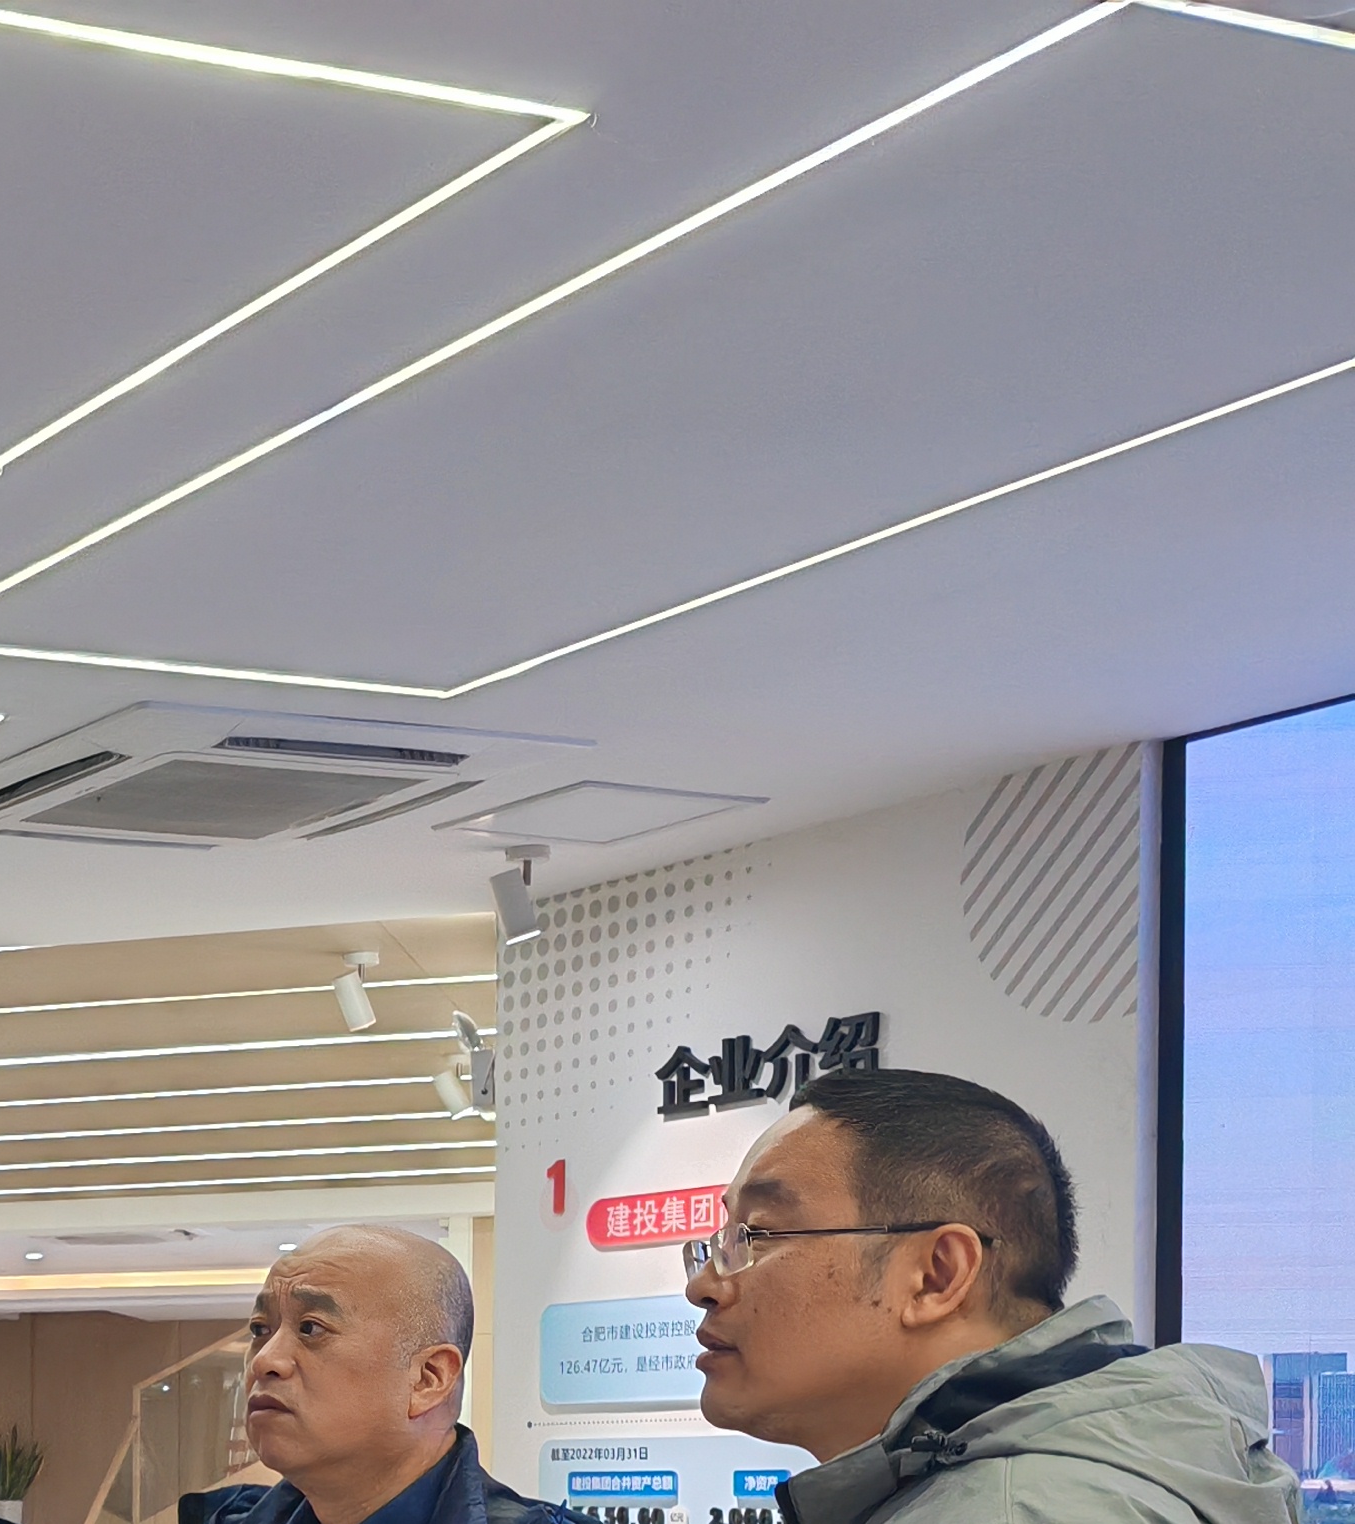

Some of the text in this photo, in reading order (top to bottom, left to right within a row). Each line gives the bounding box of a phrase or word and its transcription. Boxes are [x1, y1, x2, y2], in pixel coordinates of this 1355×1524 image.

[654, 1012, 880, 1115] 企业介绍
[546, 1159, 566, 1215] 1
